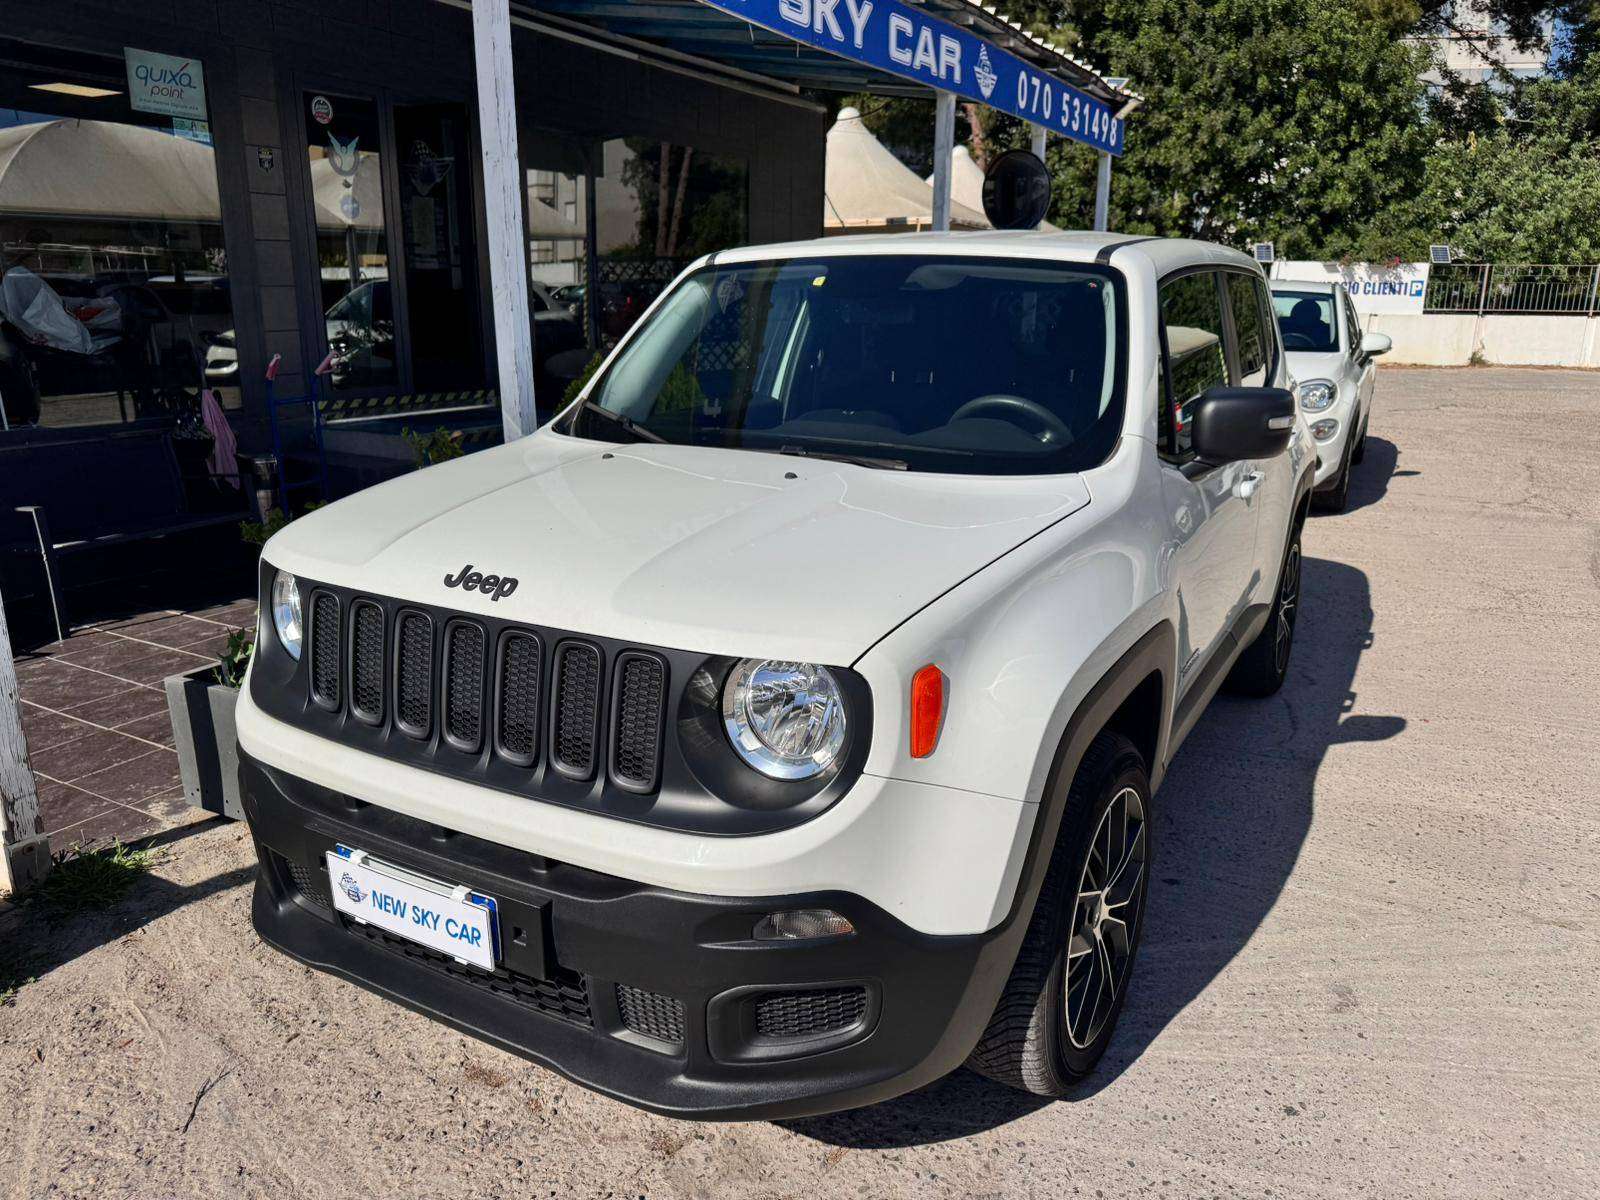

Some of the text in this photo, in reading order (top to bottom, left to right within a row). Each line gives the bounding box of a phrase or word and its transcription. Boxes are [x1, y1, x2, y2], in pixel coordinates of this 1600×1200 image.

[778, 0, 962, 84] SKY CAR
[135, 62, 197, 89] quixa
[150, 86, 185, 99] point
[1017, 71, 1052, 120] 070
[1061, 92, 1118, 147] 531498
[1363, 281, 1408, 295] CLIENTI
[443, 564, 519, 602] Jeep
[371, 889, 407, 919] NEW
[412, 905, 440, 931] SKY
[445, 918, 482, 948] CAR
